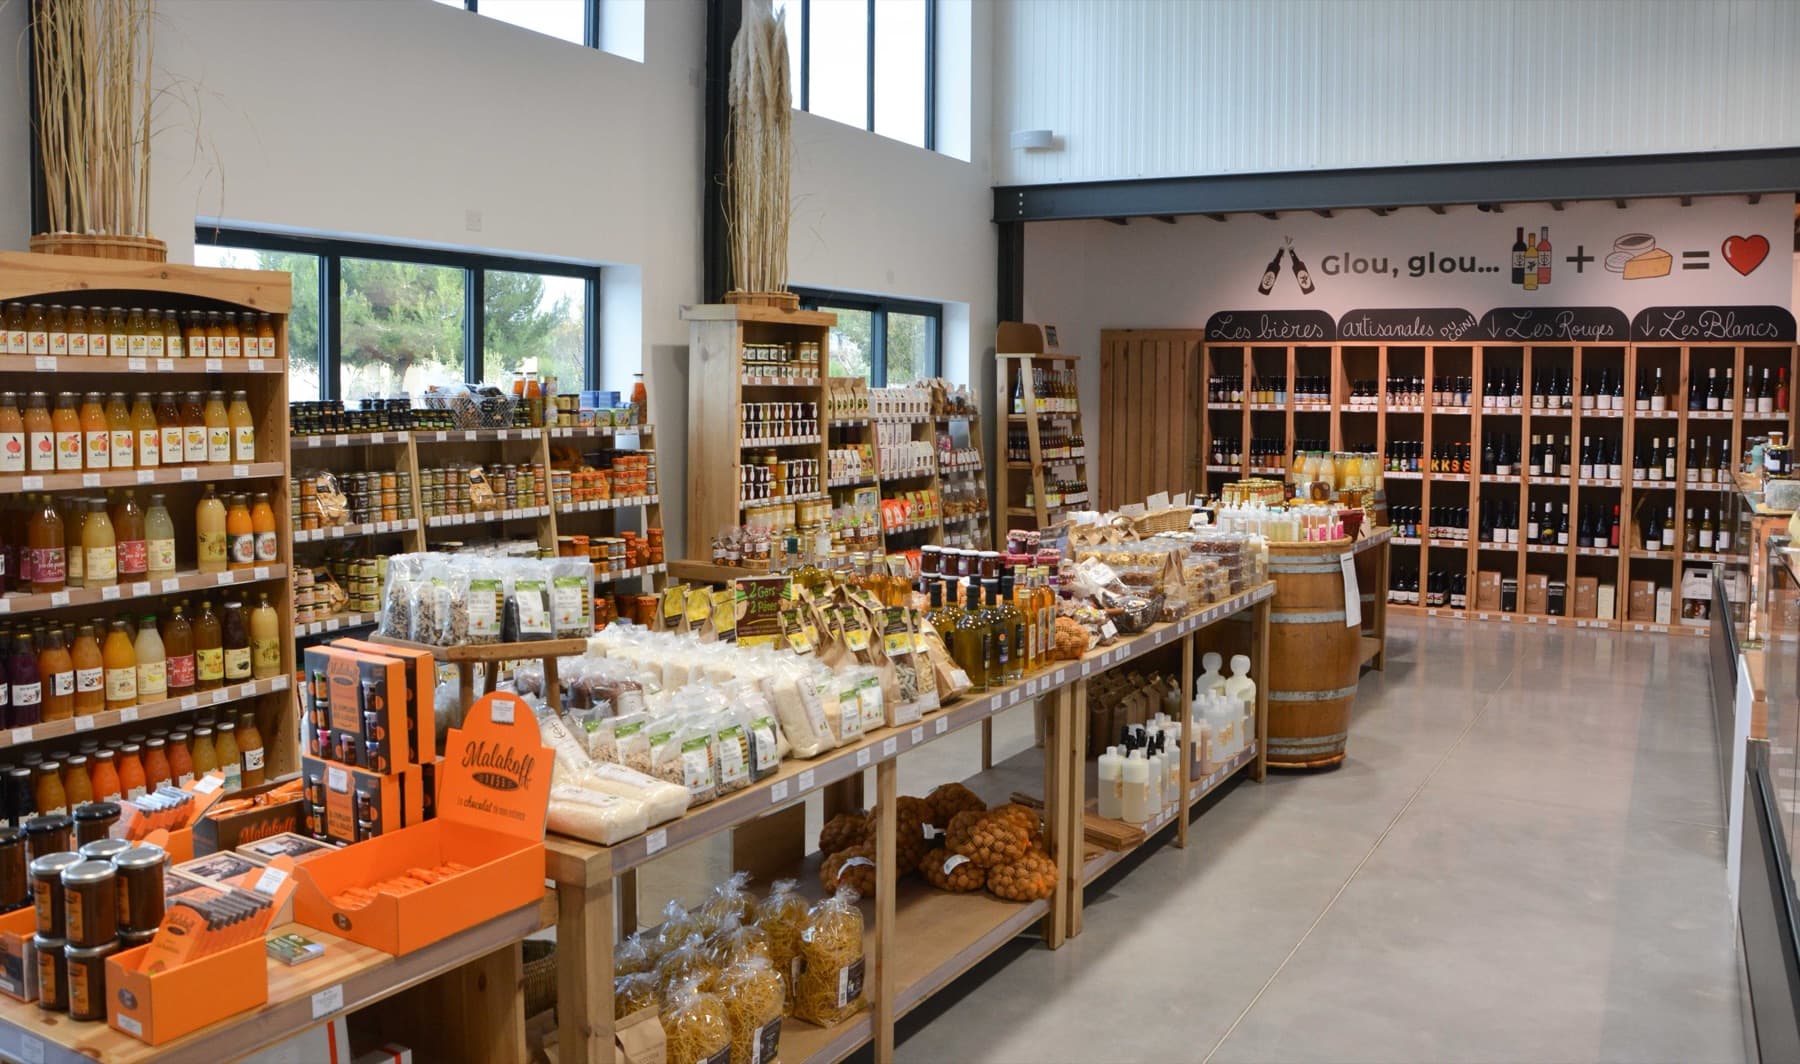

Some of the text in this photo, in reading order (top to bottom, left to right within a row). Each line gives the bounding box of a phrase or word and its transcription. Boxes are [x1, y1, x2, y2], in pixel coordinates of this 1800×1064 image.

[1321, 252, 1399, 278] Glou,
[1407, 251, 1500, 277] glou...
[1211, 313, 1435, 340] Les bières artisanales
[1505, 310, 1616, 342] Les Rouges
[1659, 310, 1779, 341] Les Blancs
[462, 740, 535, 790] Malakoff
